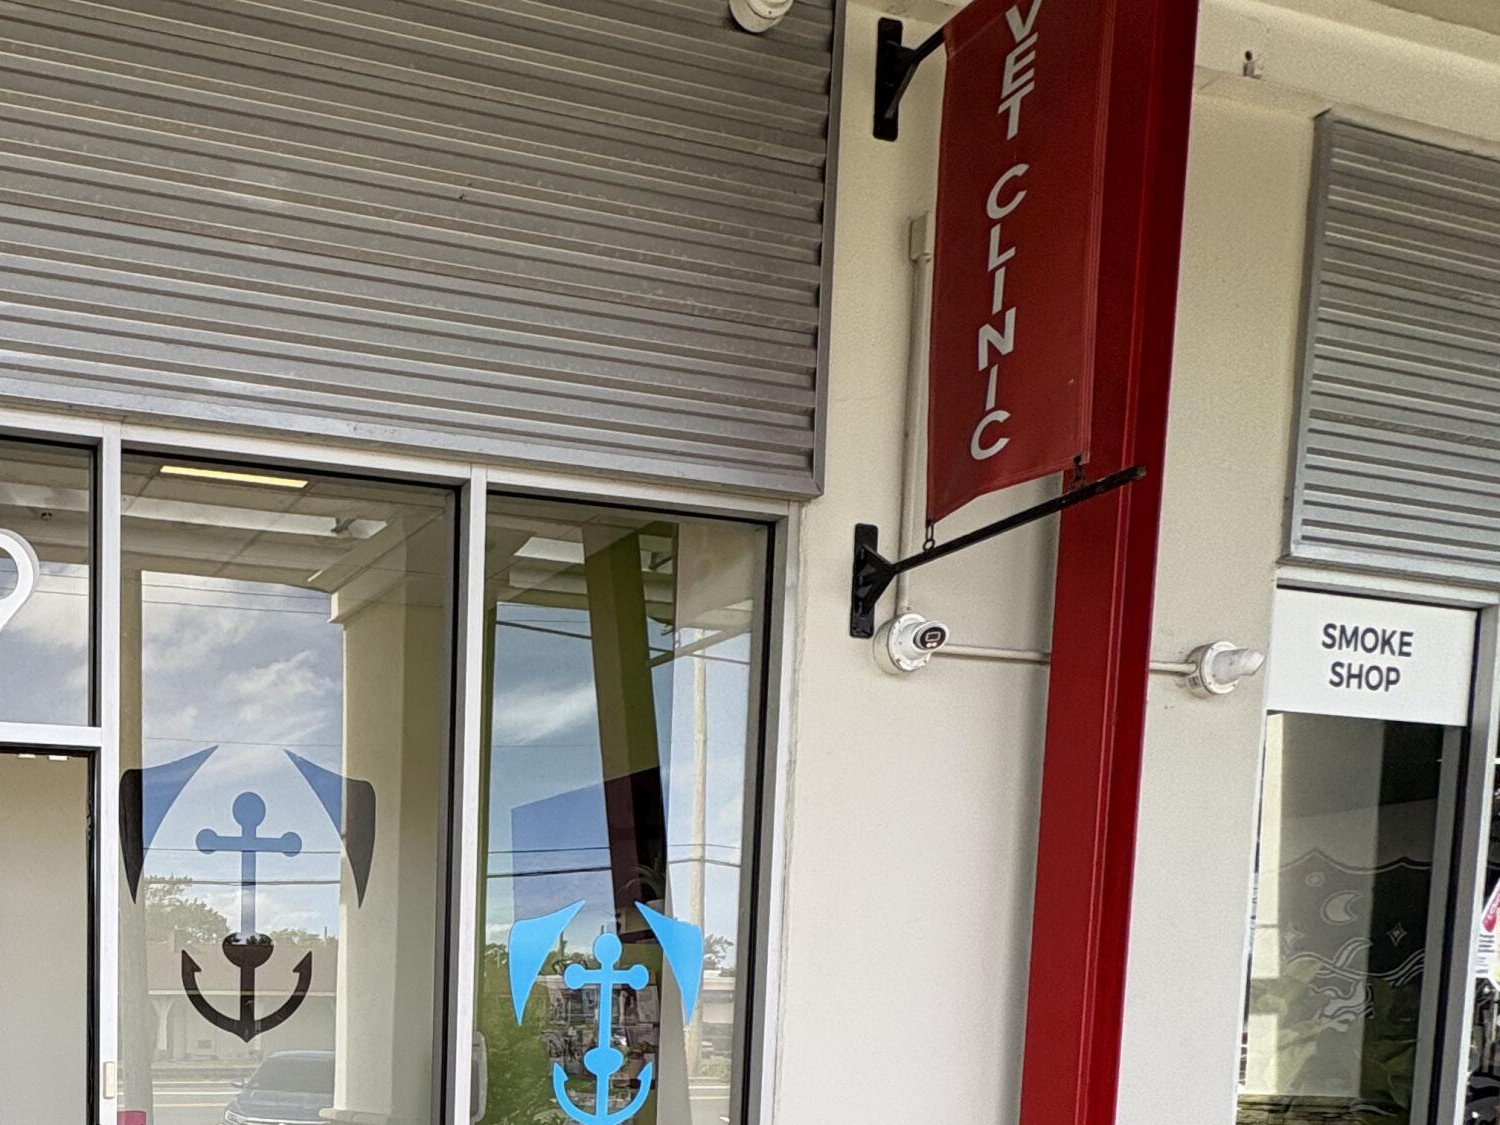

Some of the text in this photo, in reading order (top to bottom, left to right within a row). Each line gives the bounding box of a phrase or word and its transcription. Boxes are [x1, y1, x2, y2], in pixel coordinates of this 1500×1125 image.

[970, 0, 1042, 460] VET CLINIC
[1321, 623, 1414, 658] SMOKE
[1329, 661, 1401, 692] SHOP
